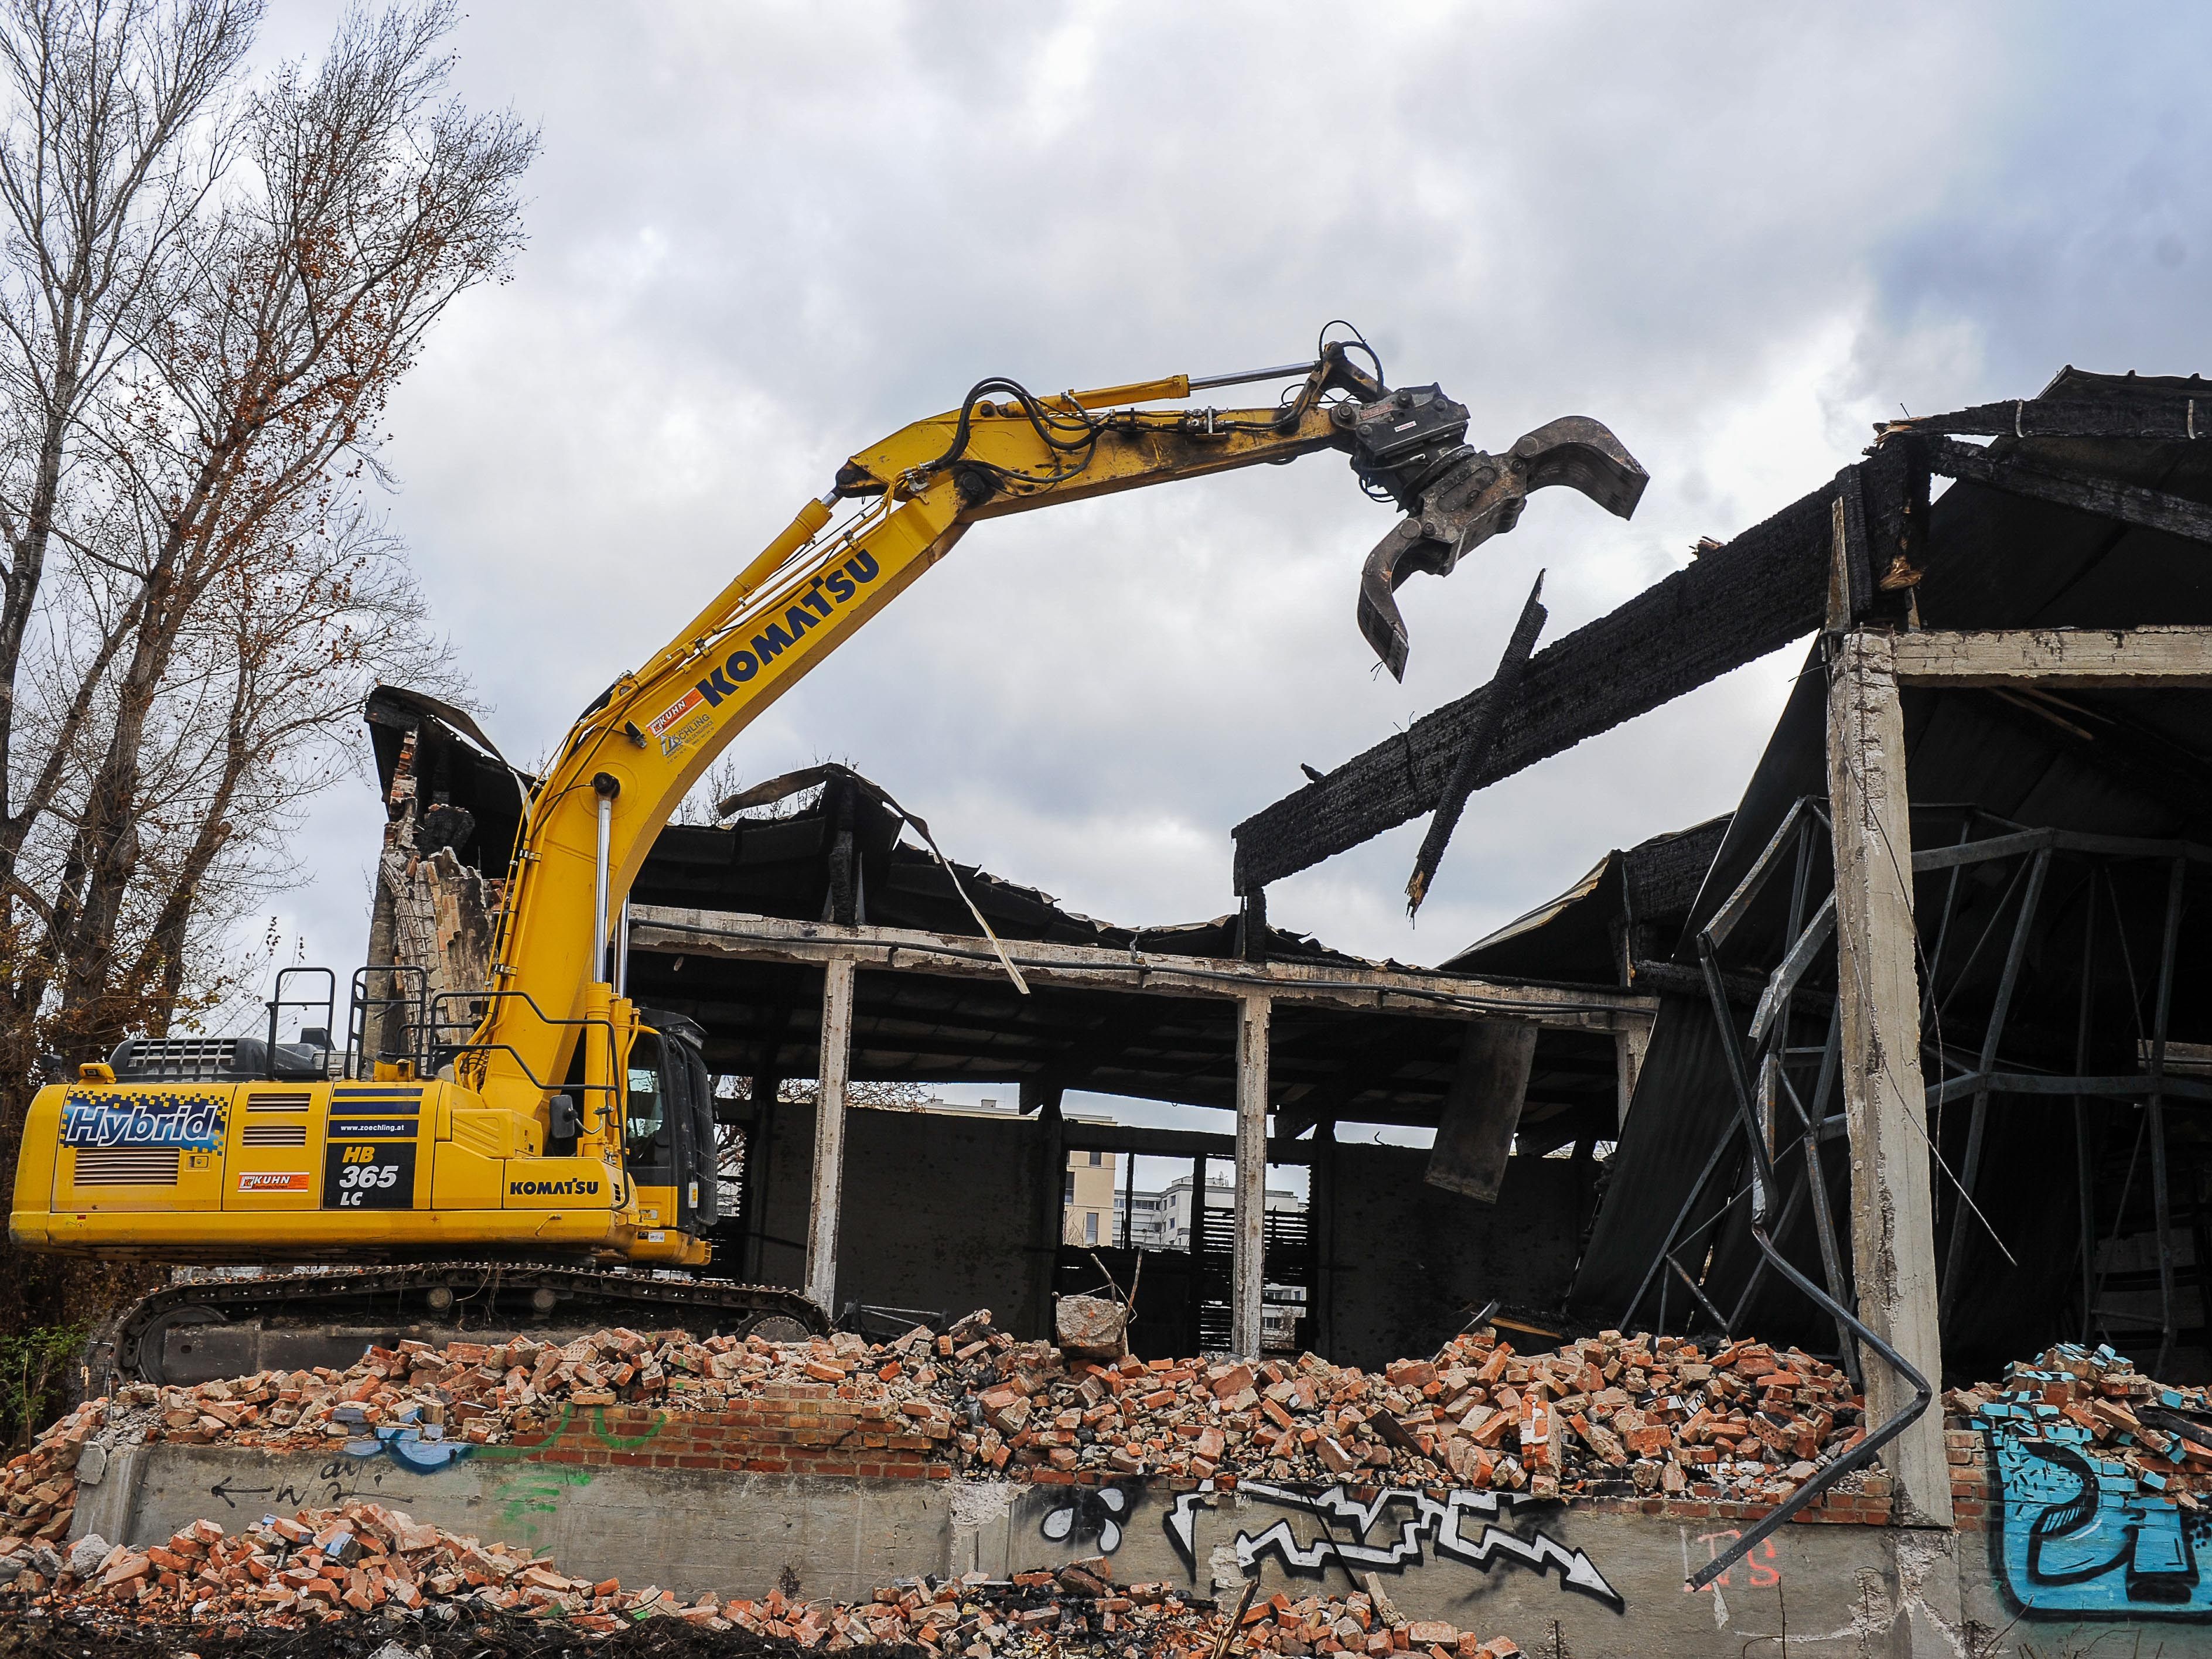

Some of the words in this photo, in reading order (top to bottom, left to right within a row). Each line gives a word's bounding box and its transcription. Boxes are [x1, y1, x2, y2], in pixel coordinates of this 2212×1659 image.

[695, 549, 879, 708] KOMATSU
[660, 700, 686, 725] KUHN
[66, 1105, 219, 1146] Hybrid
[342, 1146, 375, 1163] HB
[254, 1176, 291, 1184] KUHN
[339, 1165, 399, 1188] 365
[510, 1177, 599, 1195] KOMATSU
[340, 1192, 363, 1206] LC
